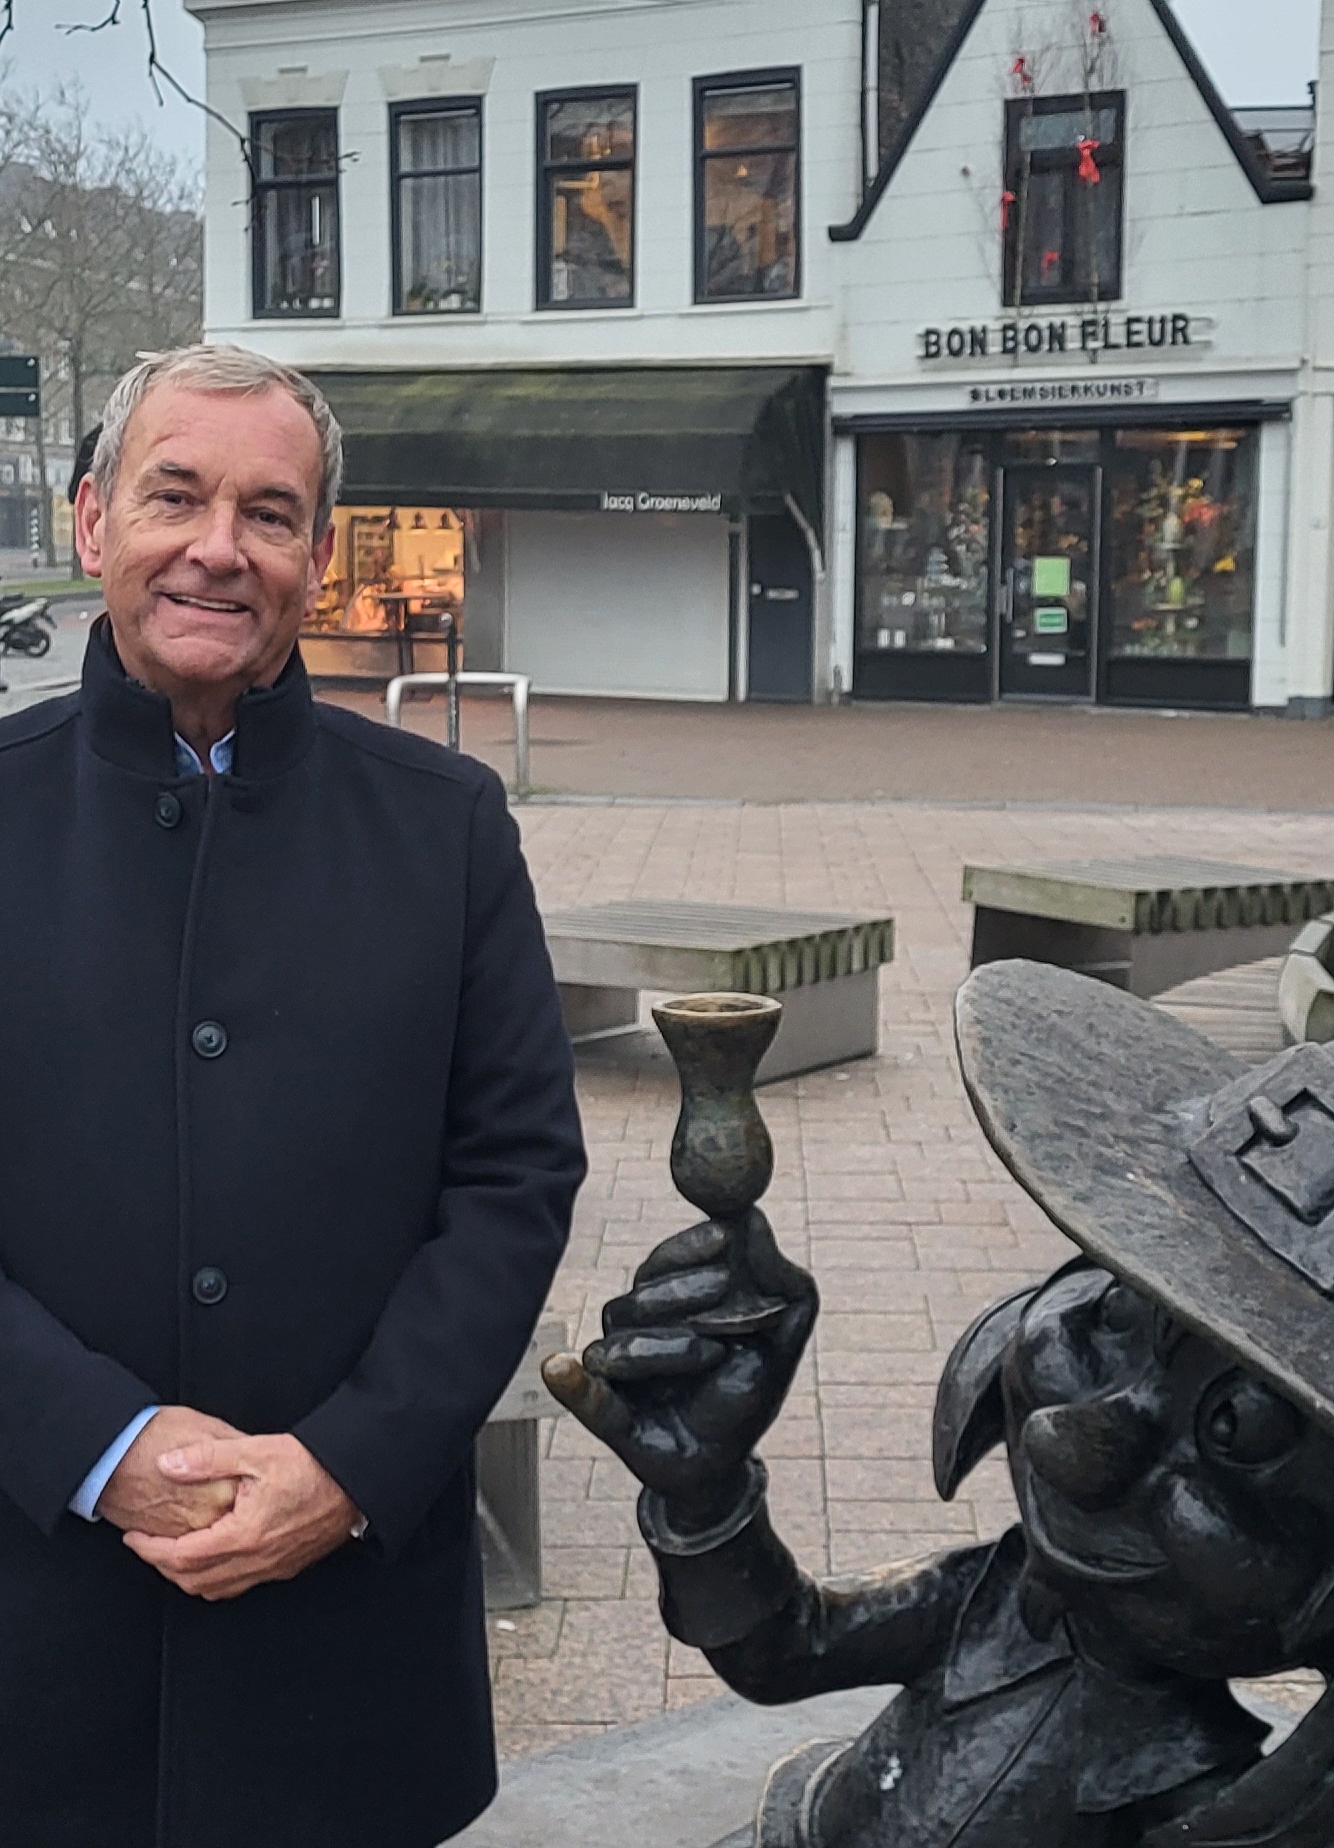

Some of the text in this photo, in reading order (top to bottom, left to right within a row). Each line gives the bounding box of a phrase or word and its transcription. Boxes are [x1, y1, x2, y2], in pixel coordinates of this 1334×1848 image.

[924, 314, 1191, 358] BON BON FLEUR
[638, 491, 721, 511] Groeneveld
